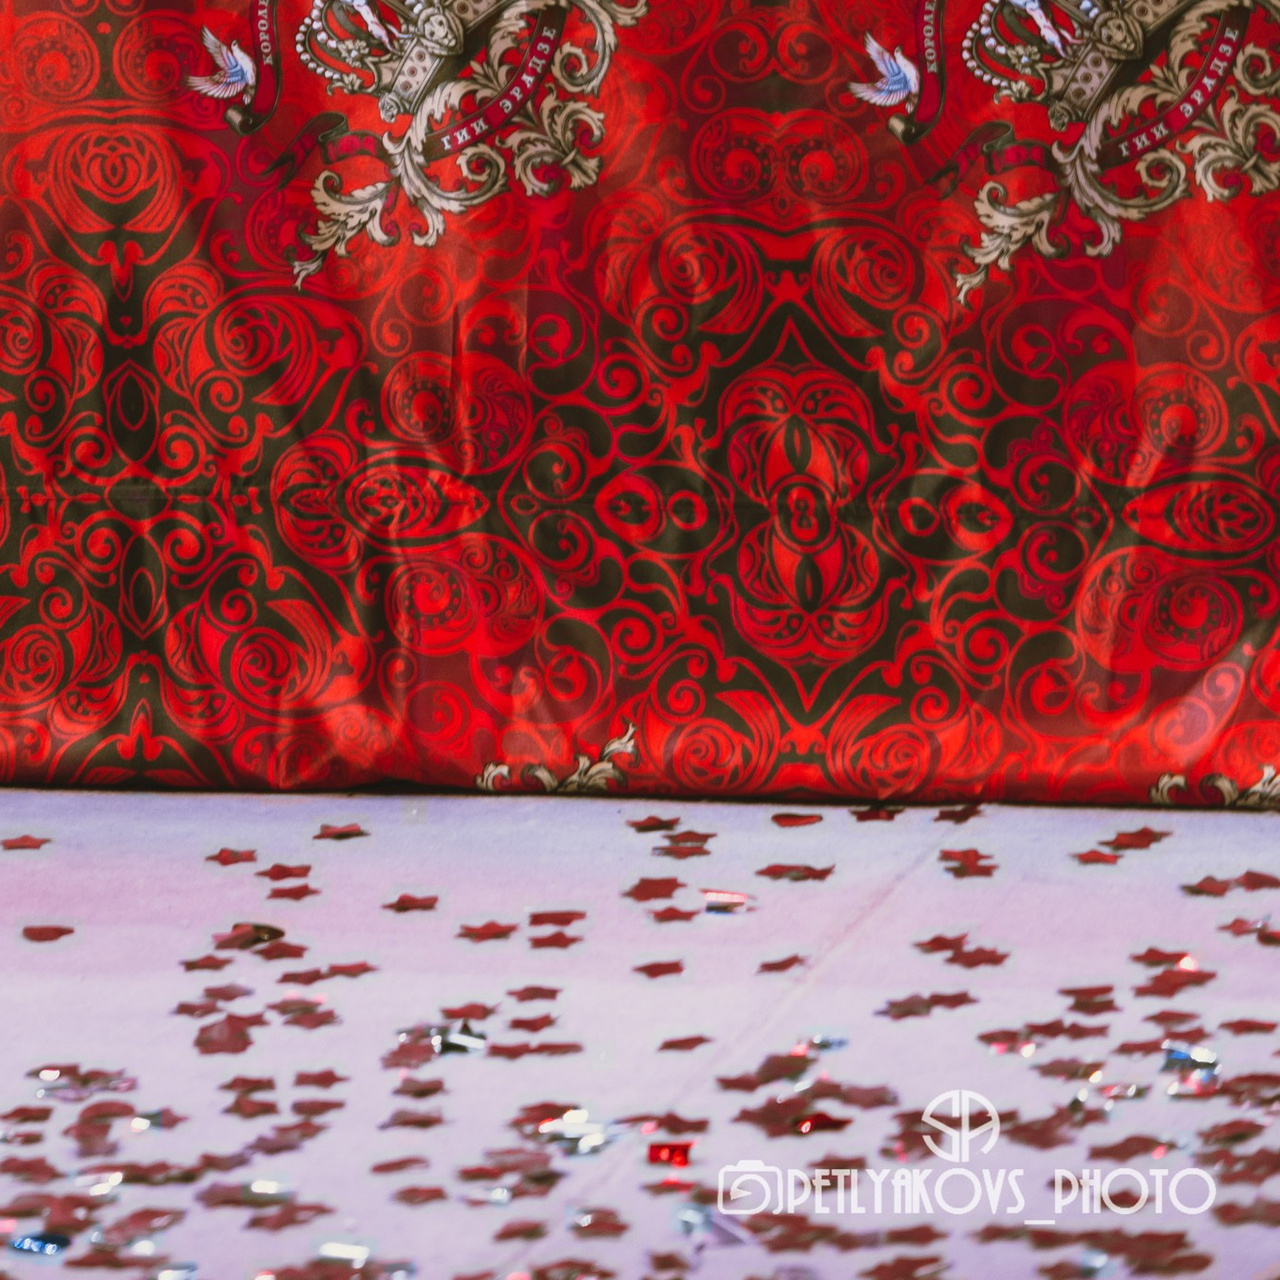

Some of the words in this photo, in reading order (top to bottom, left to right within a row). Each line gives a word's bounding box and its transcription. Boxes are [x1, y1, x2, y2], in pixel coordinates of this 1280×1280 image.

[440, 117, 489, 151] ГИИ
[501, 25, 557, 114] ЭРАДЗЕ
[1120, 123, 1169, 158] ГИИ
[1179, 26, 1240, 117] ЭРАДЗЕ
